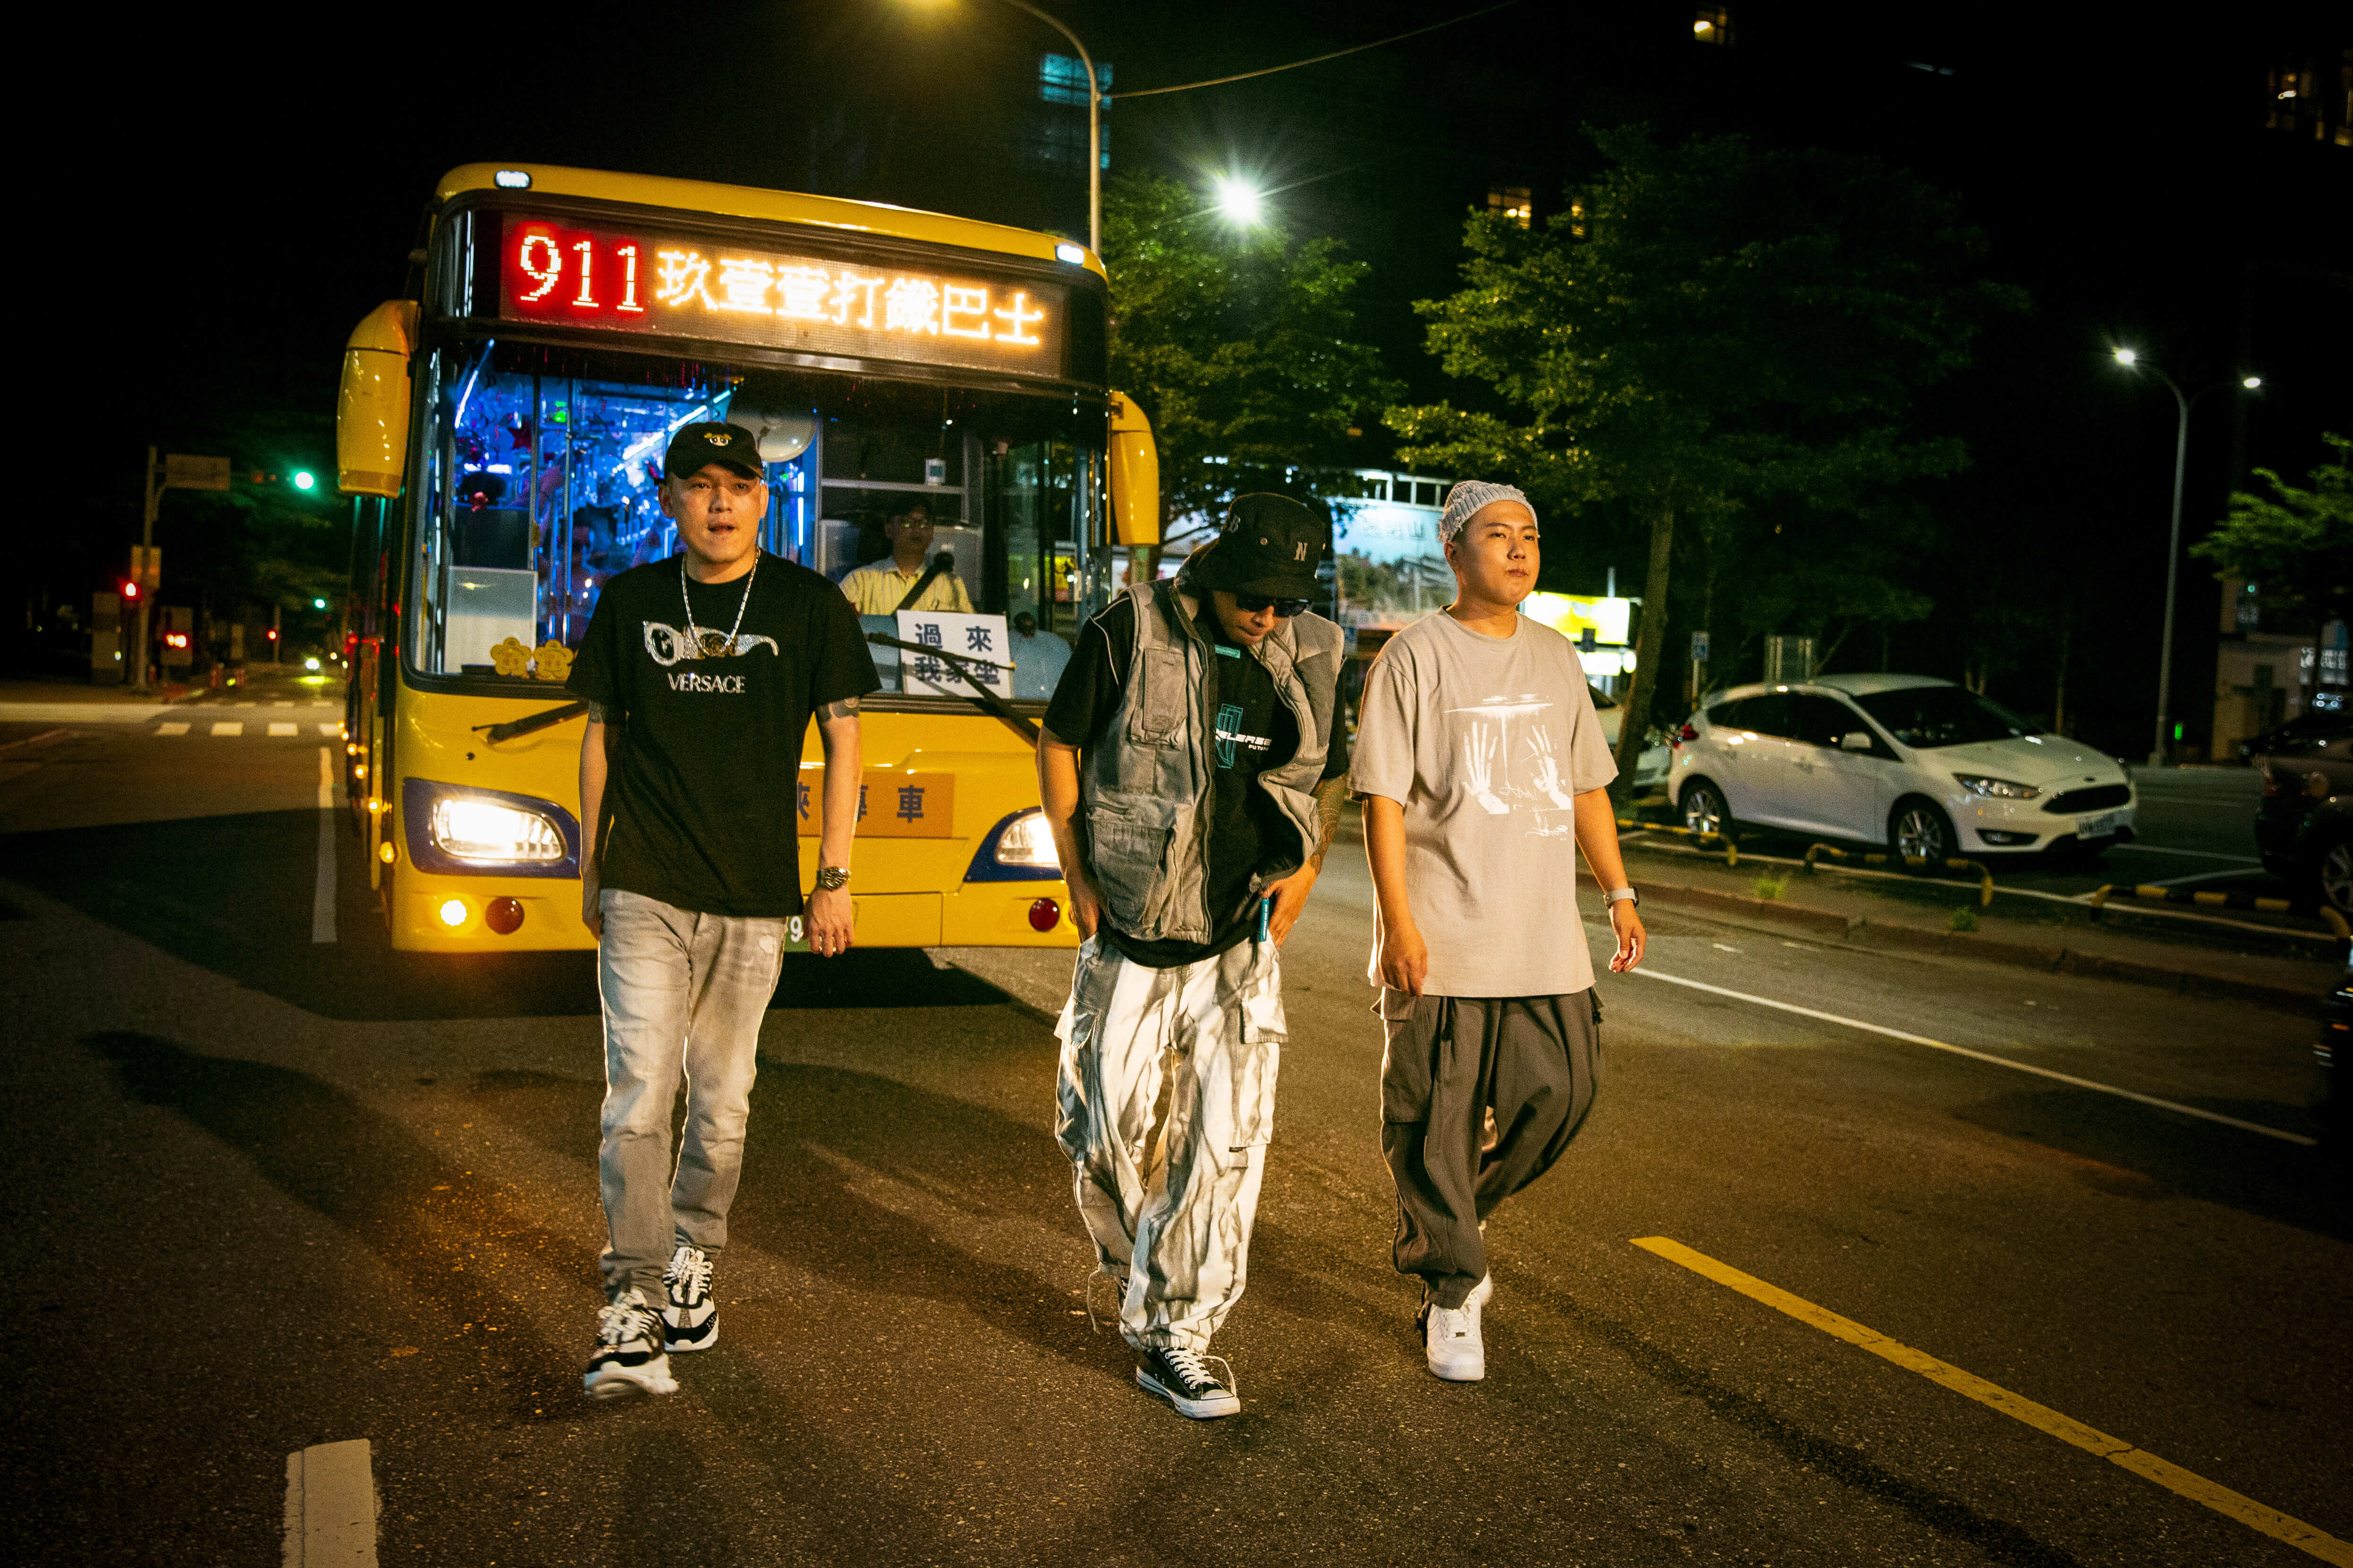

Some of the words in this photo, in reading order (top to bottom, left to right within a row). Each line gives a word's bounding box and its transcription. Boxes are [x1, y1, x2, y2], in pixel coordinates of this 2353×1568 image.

[520, 235, 643, 312] 911
[914, 623, 993, 652] 過來
[667, 673, 746, 693] VERSACE
